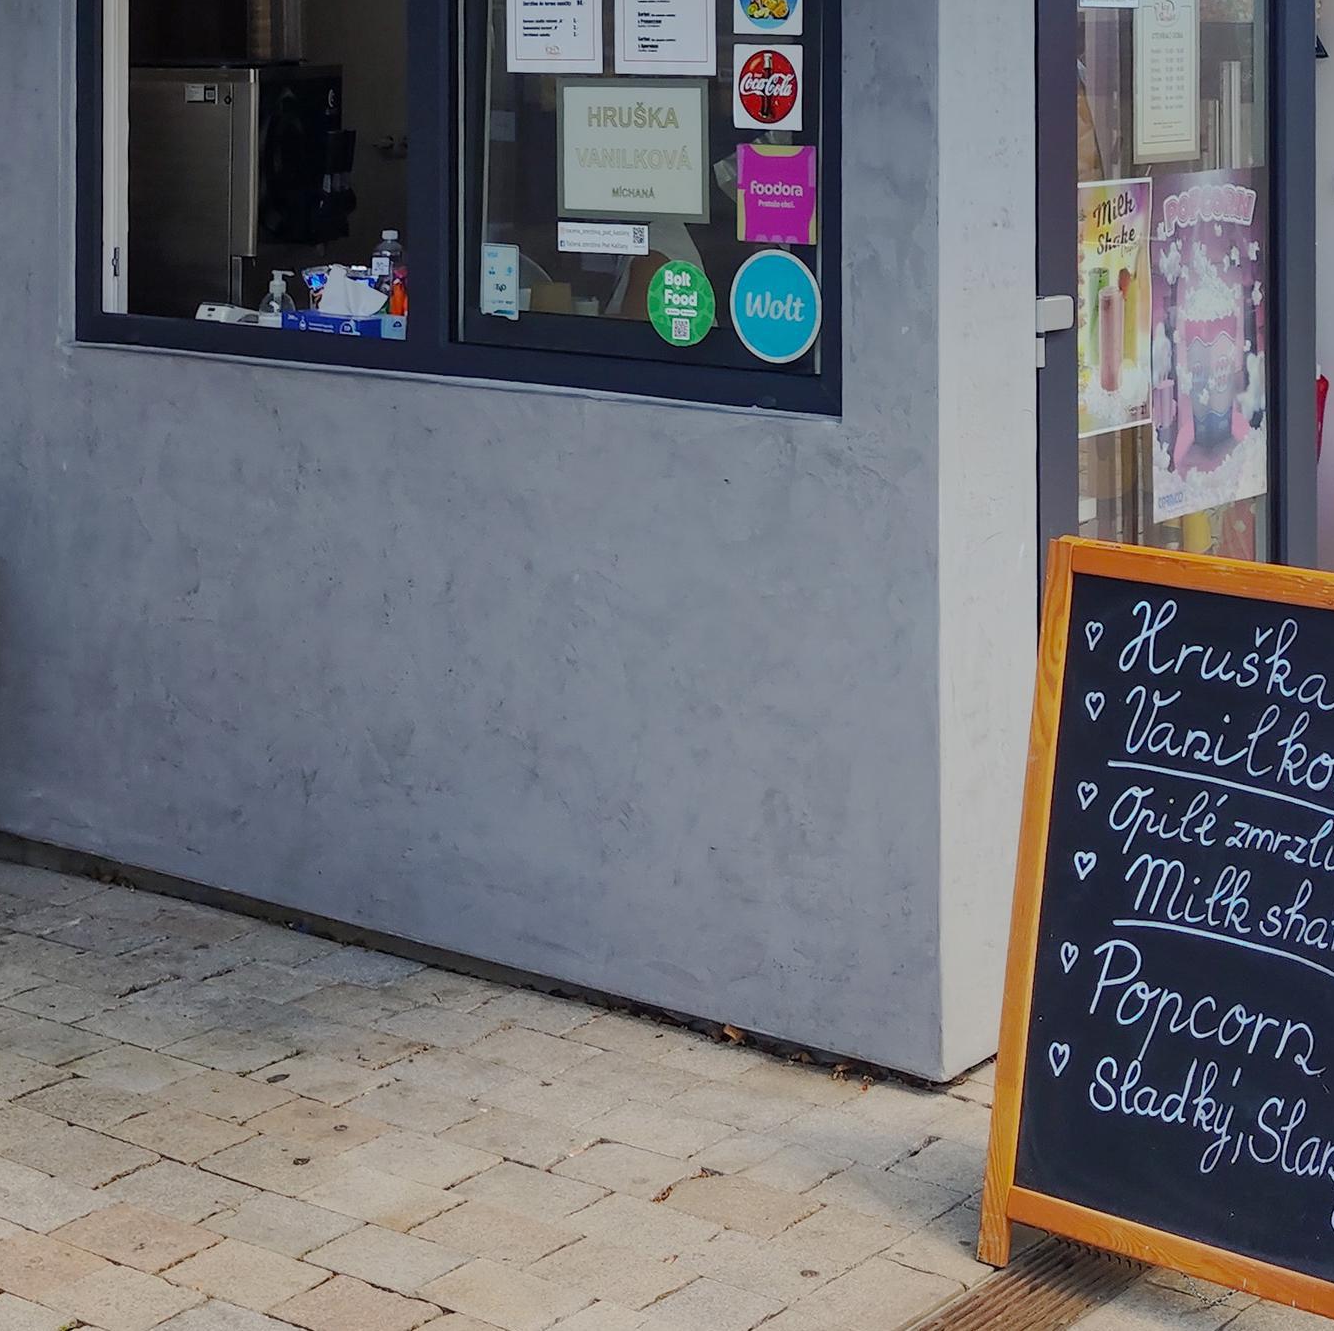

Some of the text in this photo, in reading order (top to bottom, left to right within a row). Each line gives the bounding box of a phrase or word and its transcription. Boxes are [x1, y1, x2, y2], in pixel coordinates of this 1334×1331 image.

[587, 101, 680, 129] HRUŠKA
[575, 145, 693, 170] VANILKOVÁ
[611, 185, 656, 199] MÍCHANÁ
[750, 180, 804, 197] foodora
[1093, 190, 1136, 228] Milk
[1163, 184, 1257, 237] POPCORN
[1097, 224, 1136, 255] Shake
[664, 270, 691, 289] Bolt
[664, 289, 698, 307] Food
[745, 290, 806, 322] Wolt
[1107, 785, 1228, 855] Opilé
[1123, 853, 1251, 935] Milk
[1088, 938, 1327, 1076] Popcorn
